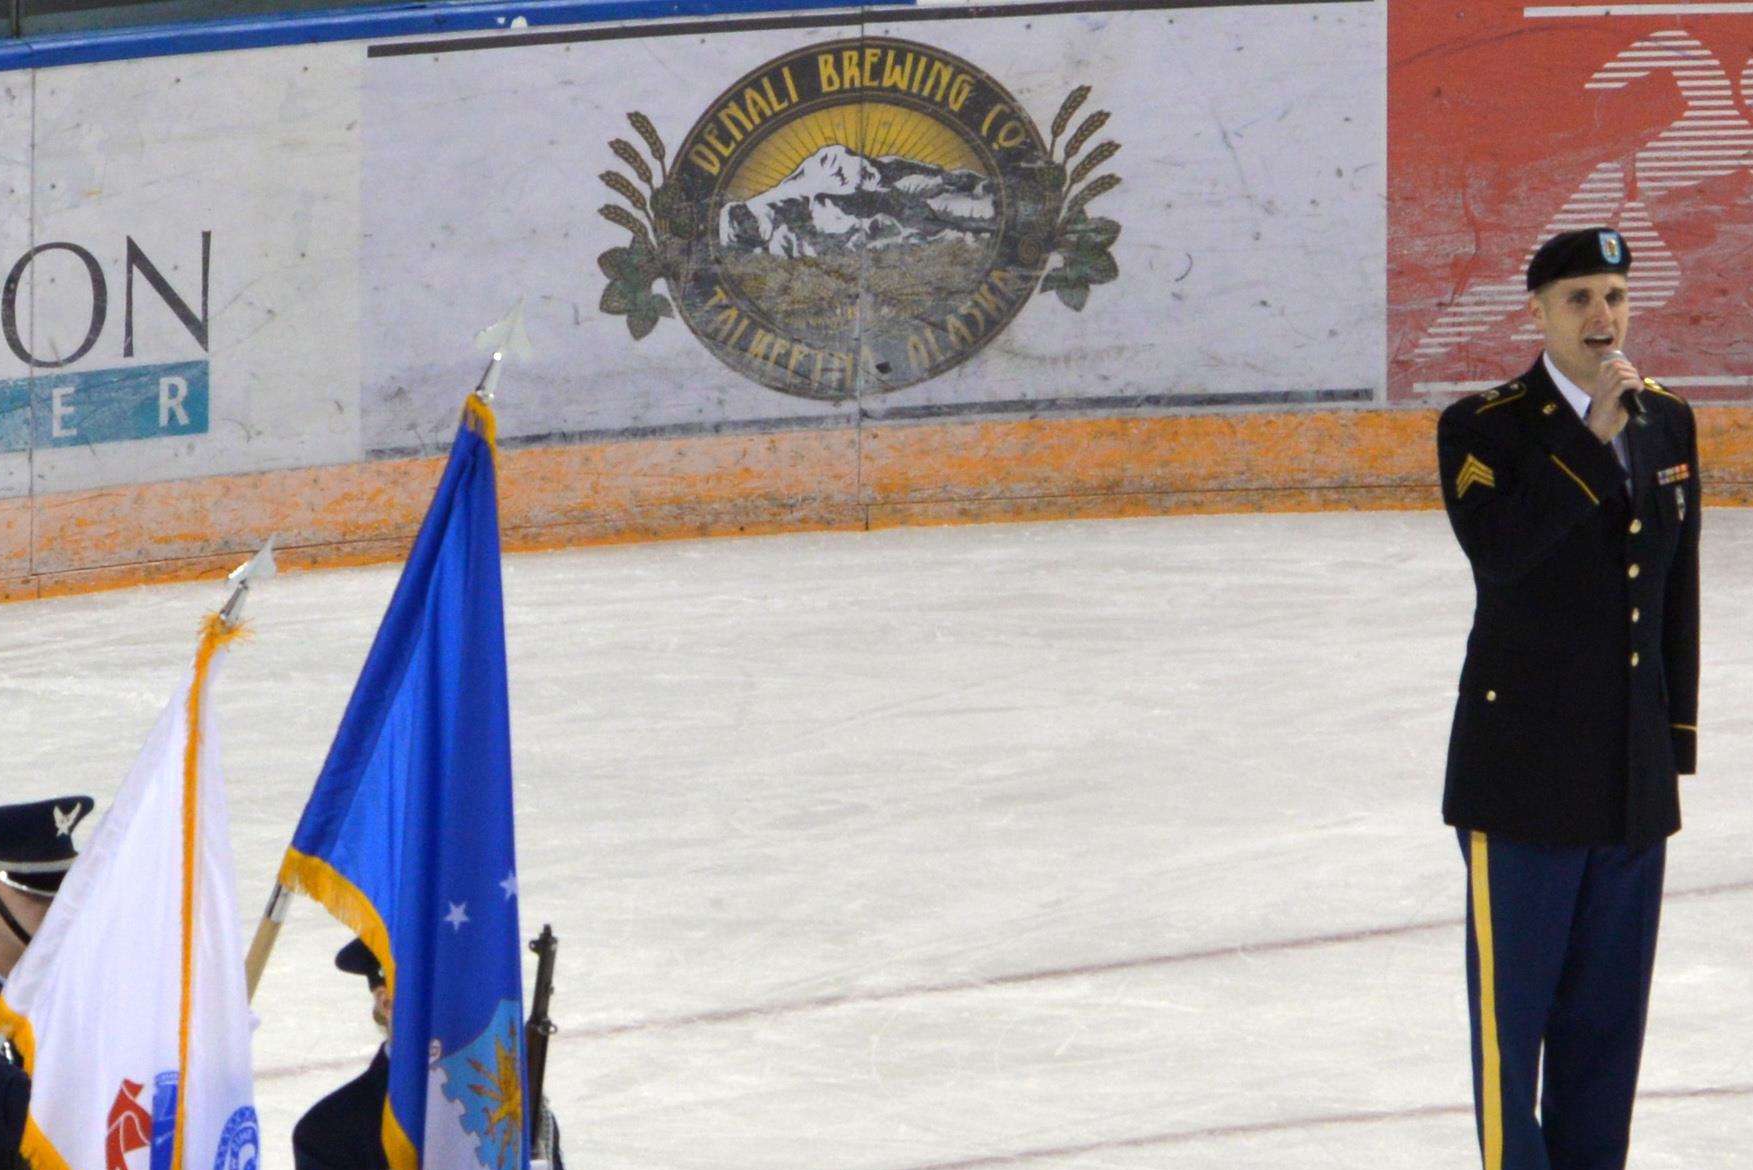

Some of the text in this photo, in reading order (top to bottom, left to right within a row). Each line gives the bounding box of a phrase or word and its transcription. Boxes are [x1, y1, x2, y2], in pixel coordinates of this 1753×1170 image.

[689, 66, 799, 177] DENALI
[818, 48, 975, 113] BREWING
[907, 270, 1017, 375] ALASKA
